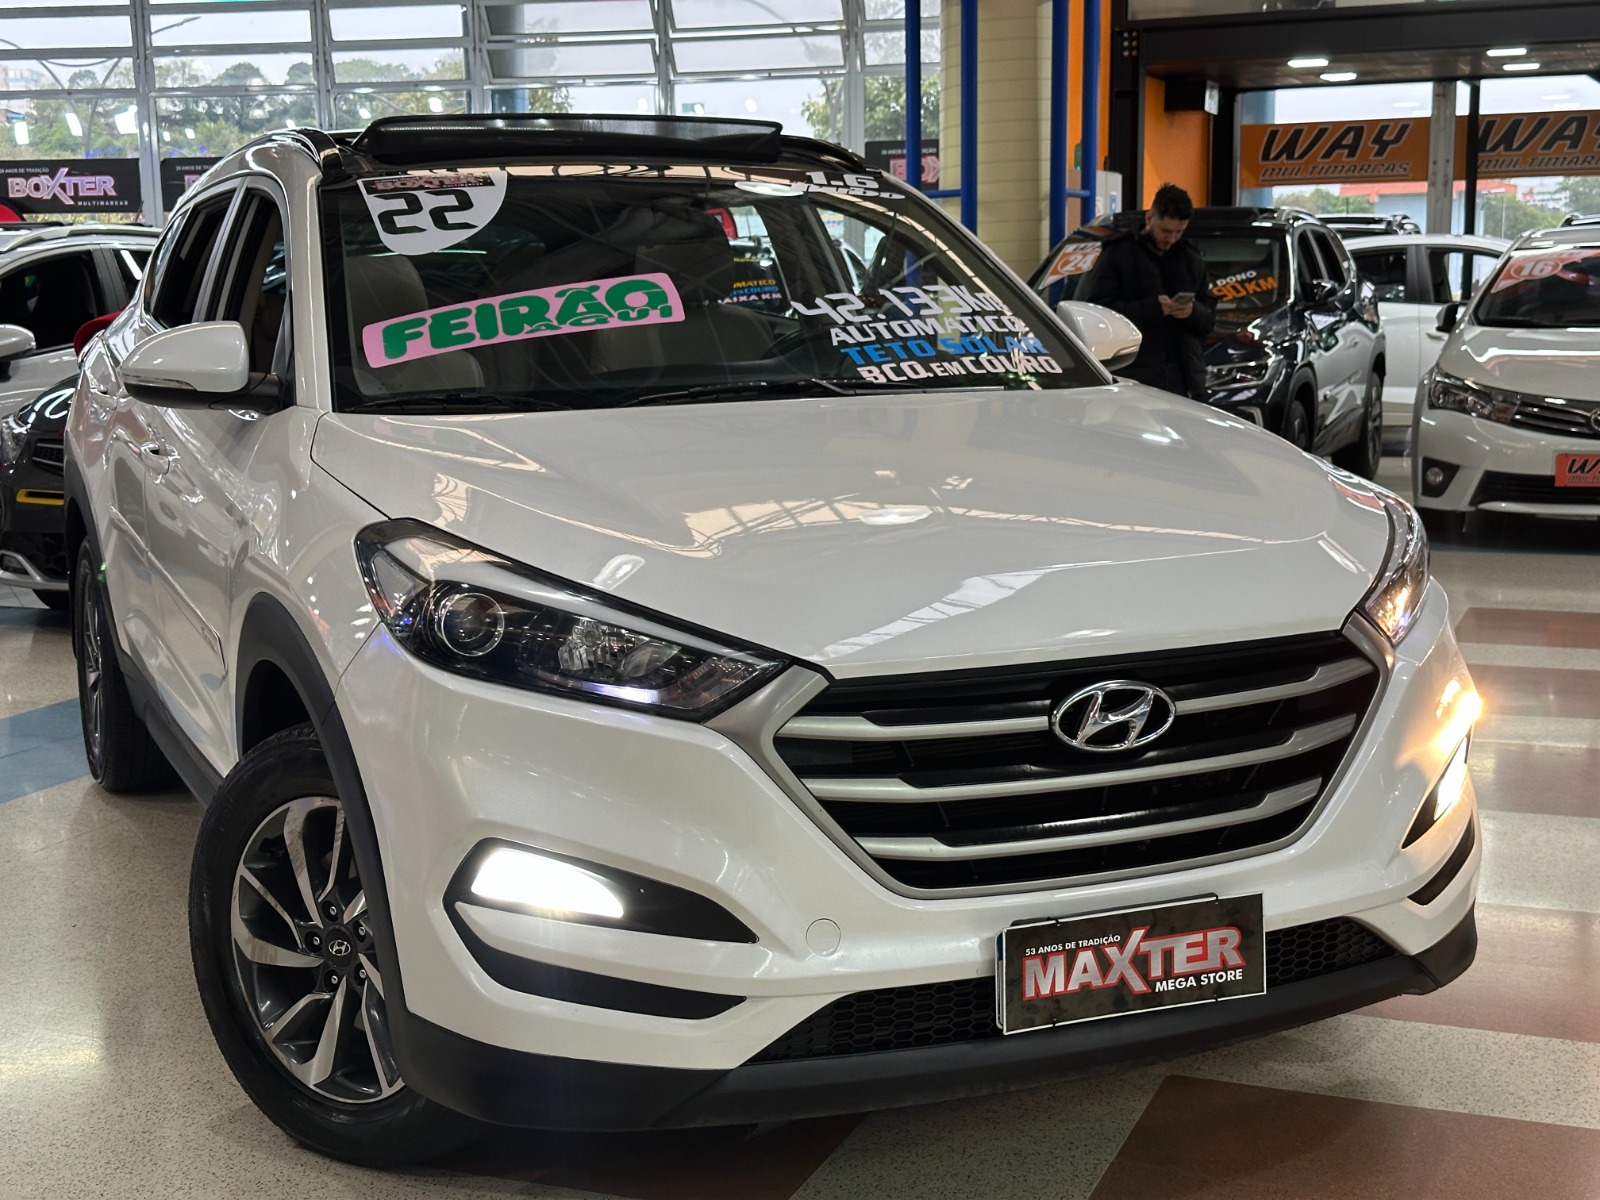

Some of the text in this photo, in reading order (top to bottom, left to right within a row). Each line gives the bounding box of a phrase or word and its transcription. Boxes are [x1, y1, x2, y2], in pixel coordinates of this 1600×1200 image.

[1260, 122, 1412, 163] WAY
[1478, 115, 1600, 153] WA
[805, 171, 880, 189] 1.6
[1261, 162, 1411, 177] MULTIMARCAS
[7, 167, 117, 206] BOXTER
[373, 188, 480, 235] 22
[1216, 269, 1258, 287] DONO
[1519, 260, 1556, 277] 16
[382, 279, 670, 360] FEIRÃO
[840, 335, 1050, 365] TETO SOLAR
[1025, 934, 1121, 956] 53 ANOS DE TRADIÇÃO
[1022, 925, 1247, 1001] MAXTER
[1154, 968, 1243, 993] MEGA STORE
